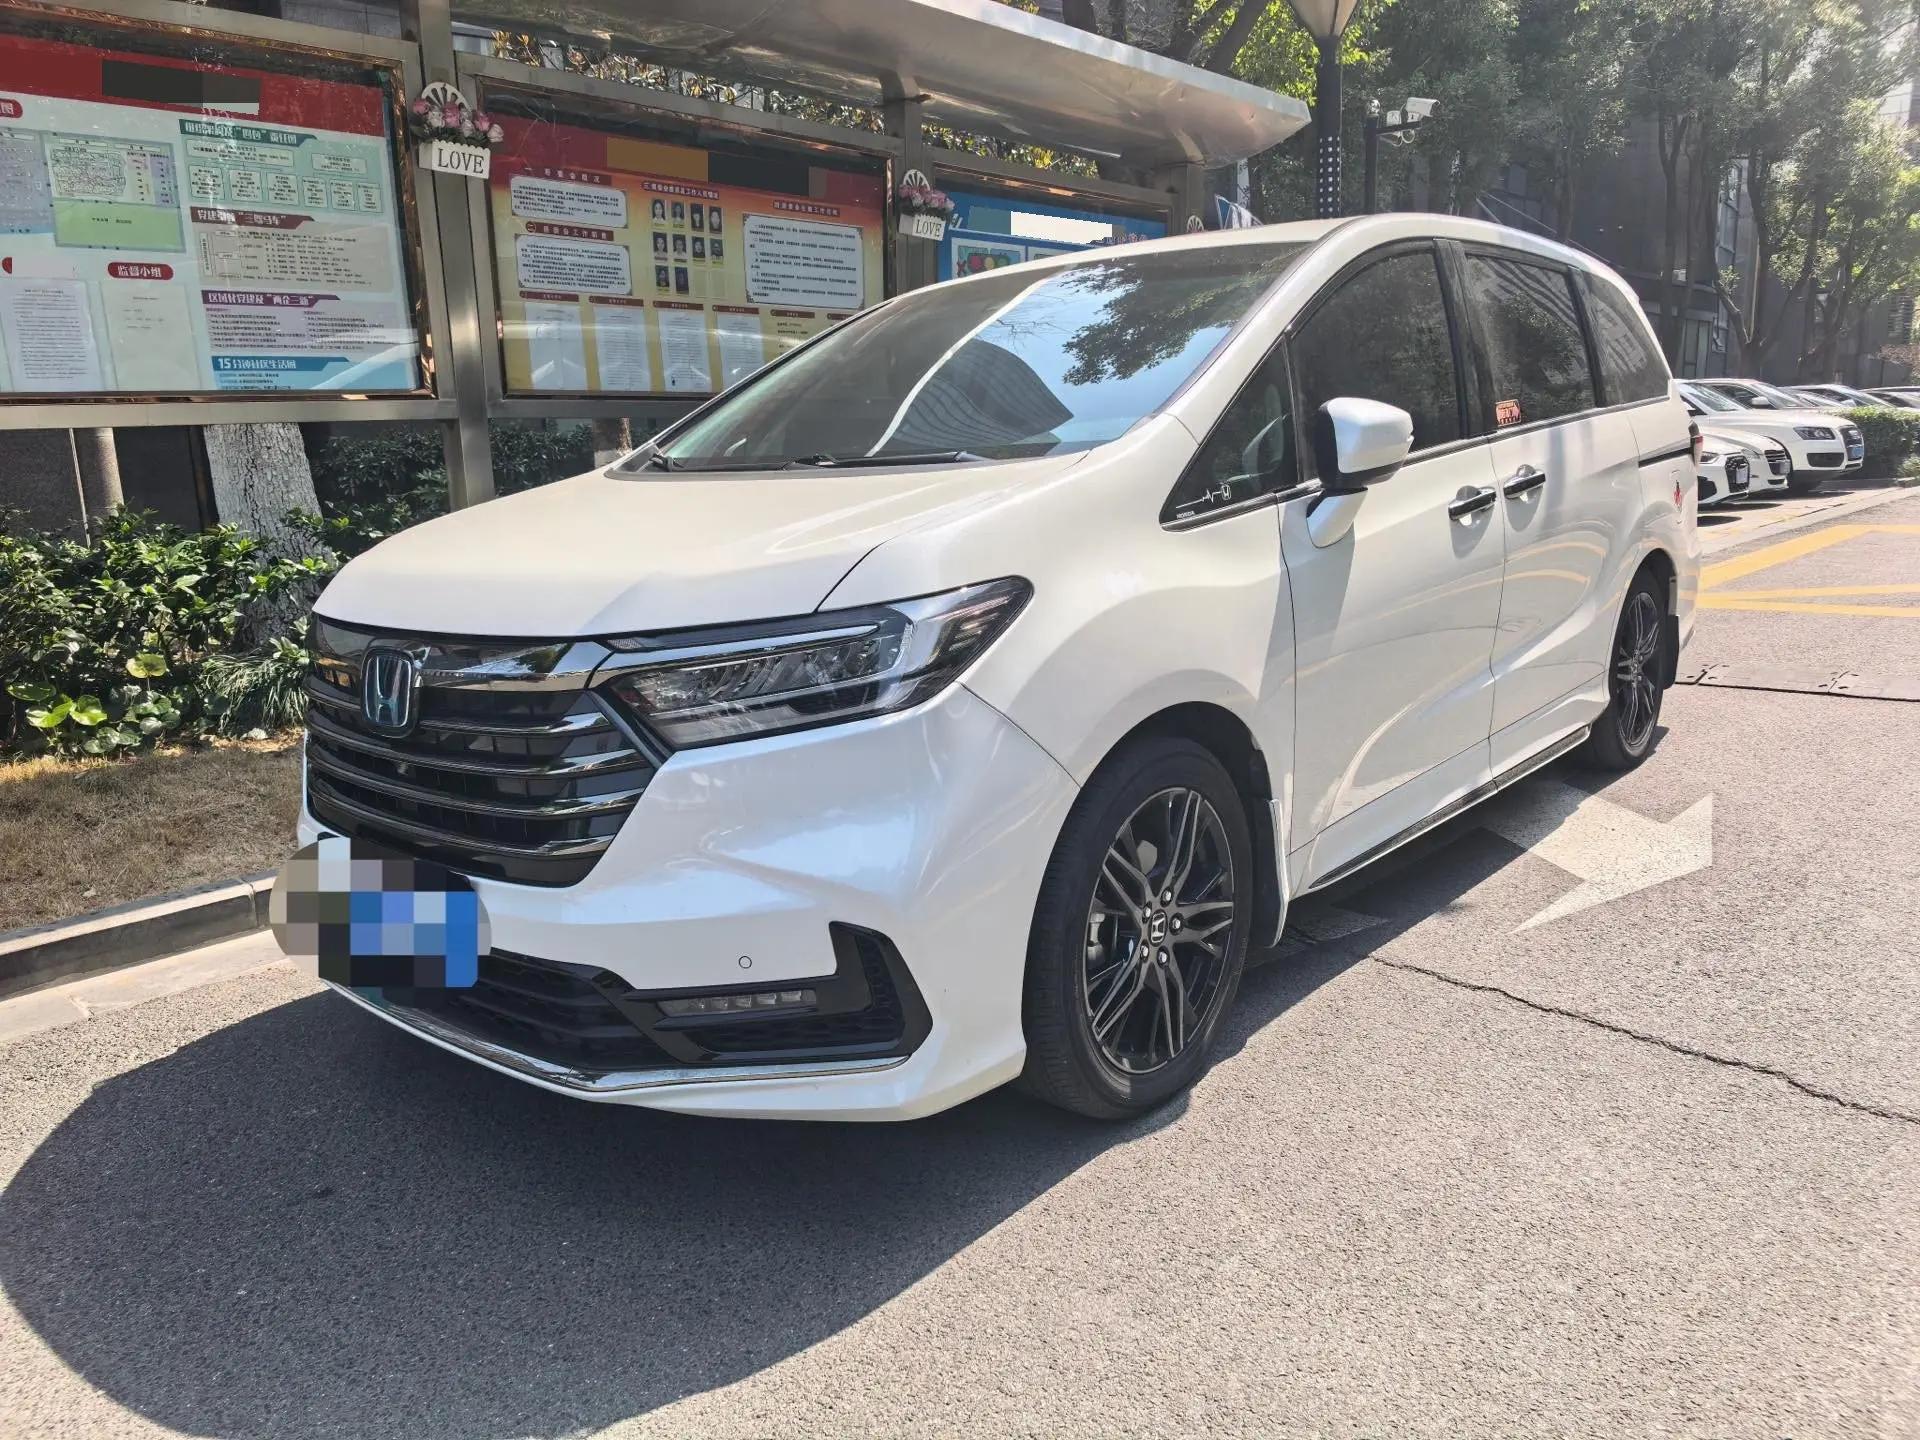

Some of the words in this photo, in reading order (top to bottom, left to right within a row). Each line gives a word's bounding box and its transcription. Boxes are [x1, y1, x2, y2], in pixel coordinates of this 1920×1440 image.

[438, 148, 484, 173] LOVE
[915, 219, 942, 237] LOVE
[117, 265, 162, 278] 监督小组
